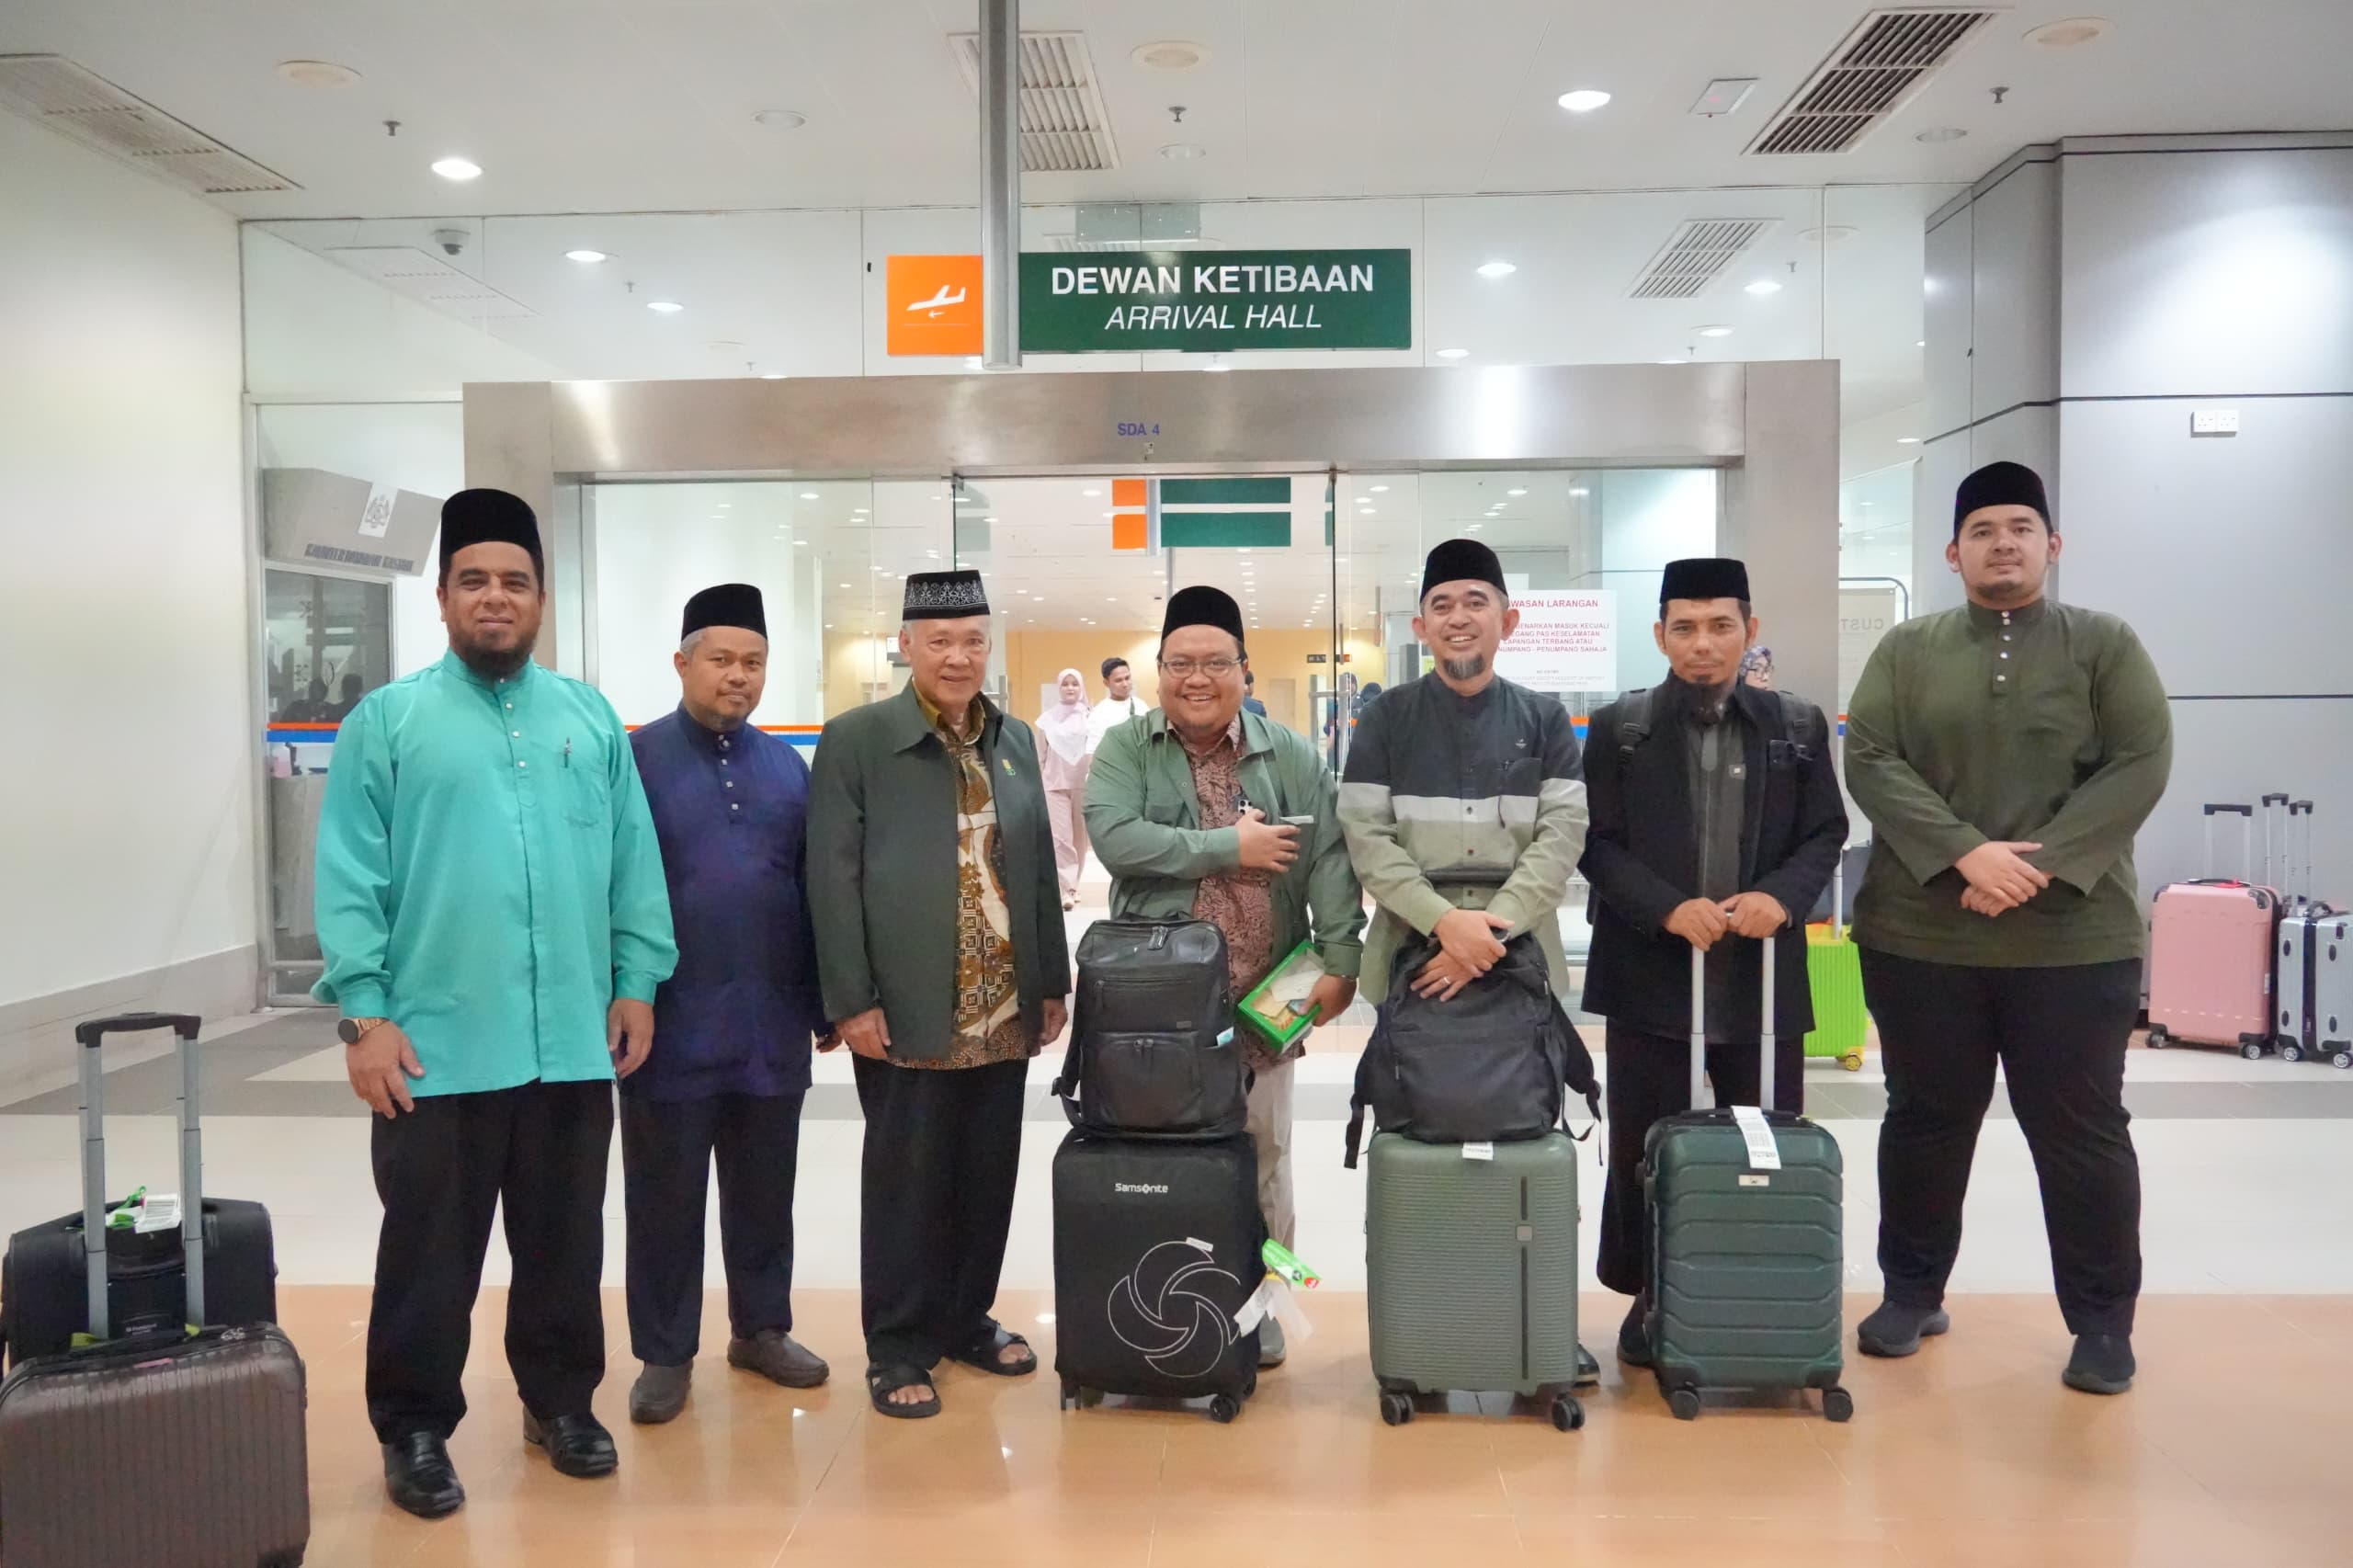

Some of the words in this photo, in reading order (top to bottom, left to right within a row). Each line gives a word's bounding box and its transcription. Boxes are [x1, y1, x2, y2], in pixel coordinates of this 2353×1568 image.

[1051, 266, 1181, 295] DEWAN
[1194, 264, 1374, 293] KETIBAAN
[1105, 305, 1236, 330] ARRIVAL
[1245, 304, 1323, 329] HALL
[1117, 422, 1147, 436] SDA
[1152, 424, 1161, 436] 4
[1547, 599, 1598, 608] LARANGAN
[1114, 1183, 1169, 1194] Samsonite
